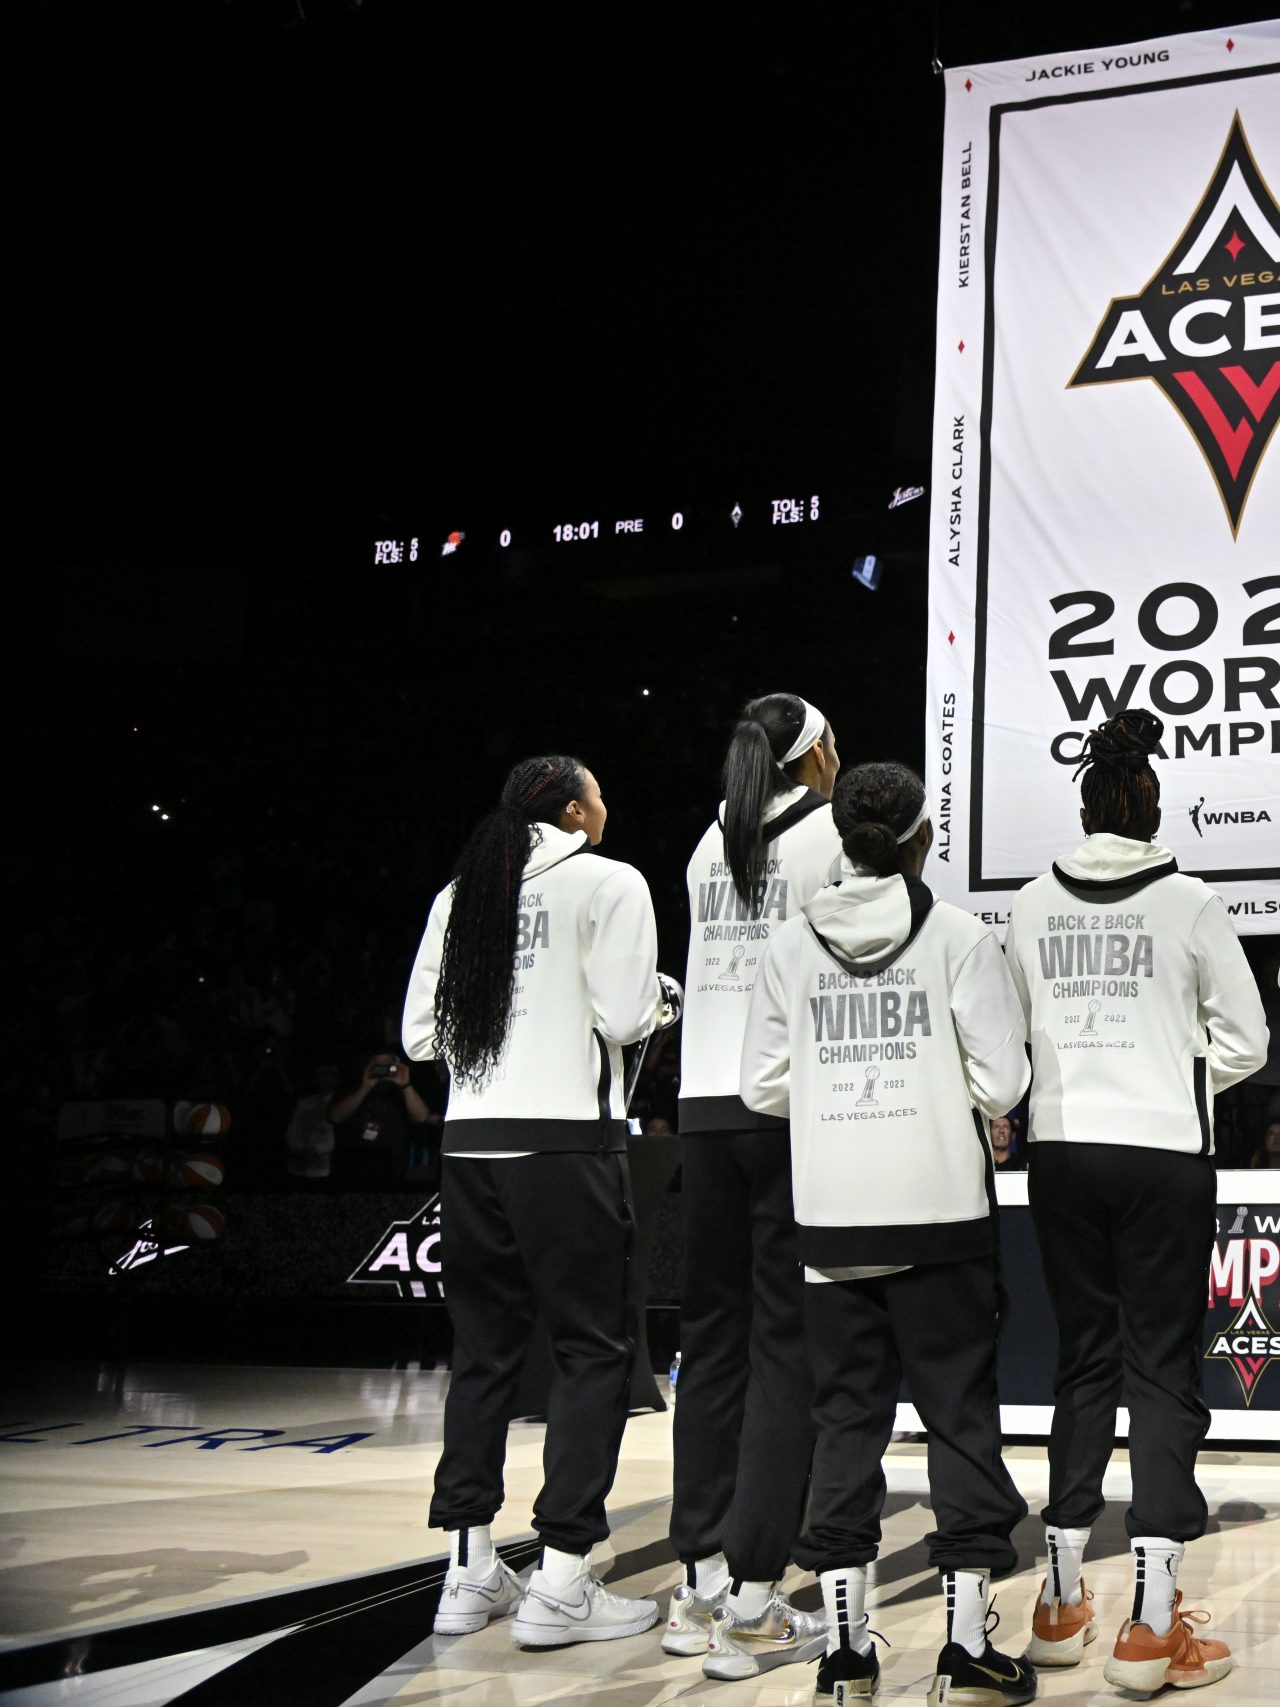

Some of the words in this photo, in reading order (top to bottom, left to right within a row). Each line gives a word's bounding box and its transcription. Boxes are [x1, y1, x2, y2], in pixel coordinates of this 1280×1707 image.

[1025, 61, 1095, 82] JACKIE
[1102, 49, 1170, 71] YOUNG
[961, 141, 972, 189] BELL
[958, 194, 972, 288] KIERSTAN
[1161, 278, 1211, 296] LAS
[951, 414, 965, 480] CLARK
[771, 500, 804, 514] TOL:
[810, 495, 819, 509] 5
[671, 512, 683, 530] 0
[772, 510, 804, 525] FLS:
[810, 508, 819, 521] 0
[948, 485, 962, 567] ALYSHA
[500, 529, 511, 548] 0
[553, 521, 599, 542] 18:01
[615, 518, 644, 535] PRE
[410, 537, 419, 550] 5
[409, 549, 418, 562] 0
[942, 692, 956, 775] COATES
[938, 782, 952, 863] ALAINA
[1203, 810, 1272, 826] WNBA
[1047, 914, 1086, 931] BACK
[1090, 915, 1100, 930] 2
[1104, 914, 1146, 930] BACK
[703, 923, 770, 942] CHAMPIONS
[1038, 933, 1153, 980] WNBA
[708, 984, 745, 992] VEGAS
[818, 972, 859, 990] BACK
[863, 970, 873, 988] 2
[877, 968, 917, 987] BACK
[1052, 980, 1139, 999] CHAMPIONS
[809, 990, 932, 1042] WNBA
[1104, 1014, 1127, 1023] 2023
[818, 1041, 917, 1065] CHAMPIONS
[1073, 1041, 1104, 1049] VEGAS
[1105, 1041, 1135, 1049] ACES
[832, 1083, 855, 1092] 2022
[883, 1079, 905, 1090] 2023
[821, 1112, 845, 1122] LAS
[846, 1110, 886, 1121] VEGAS
[887, 1107, 918, 1118] ACES
[0, 1421, 375, 1453] LTRA
